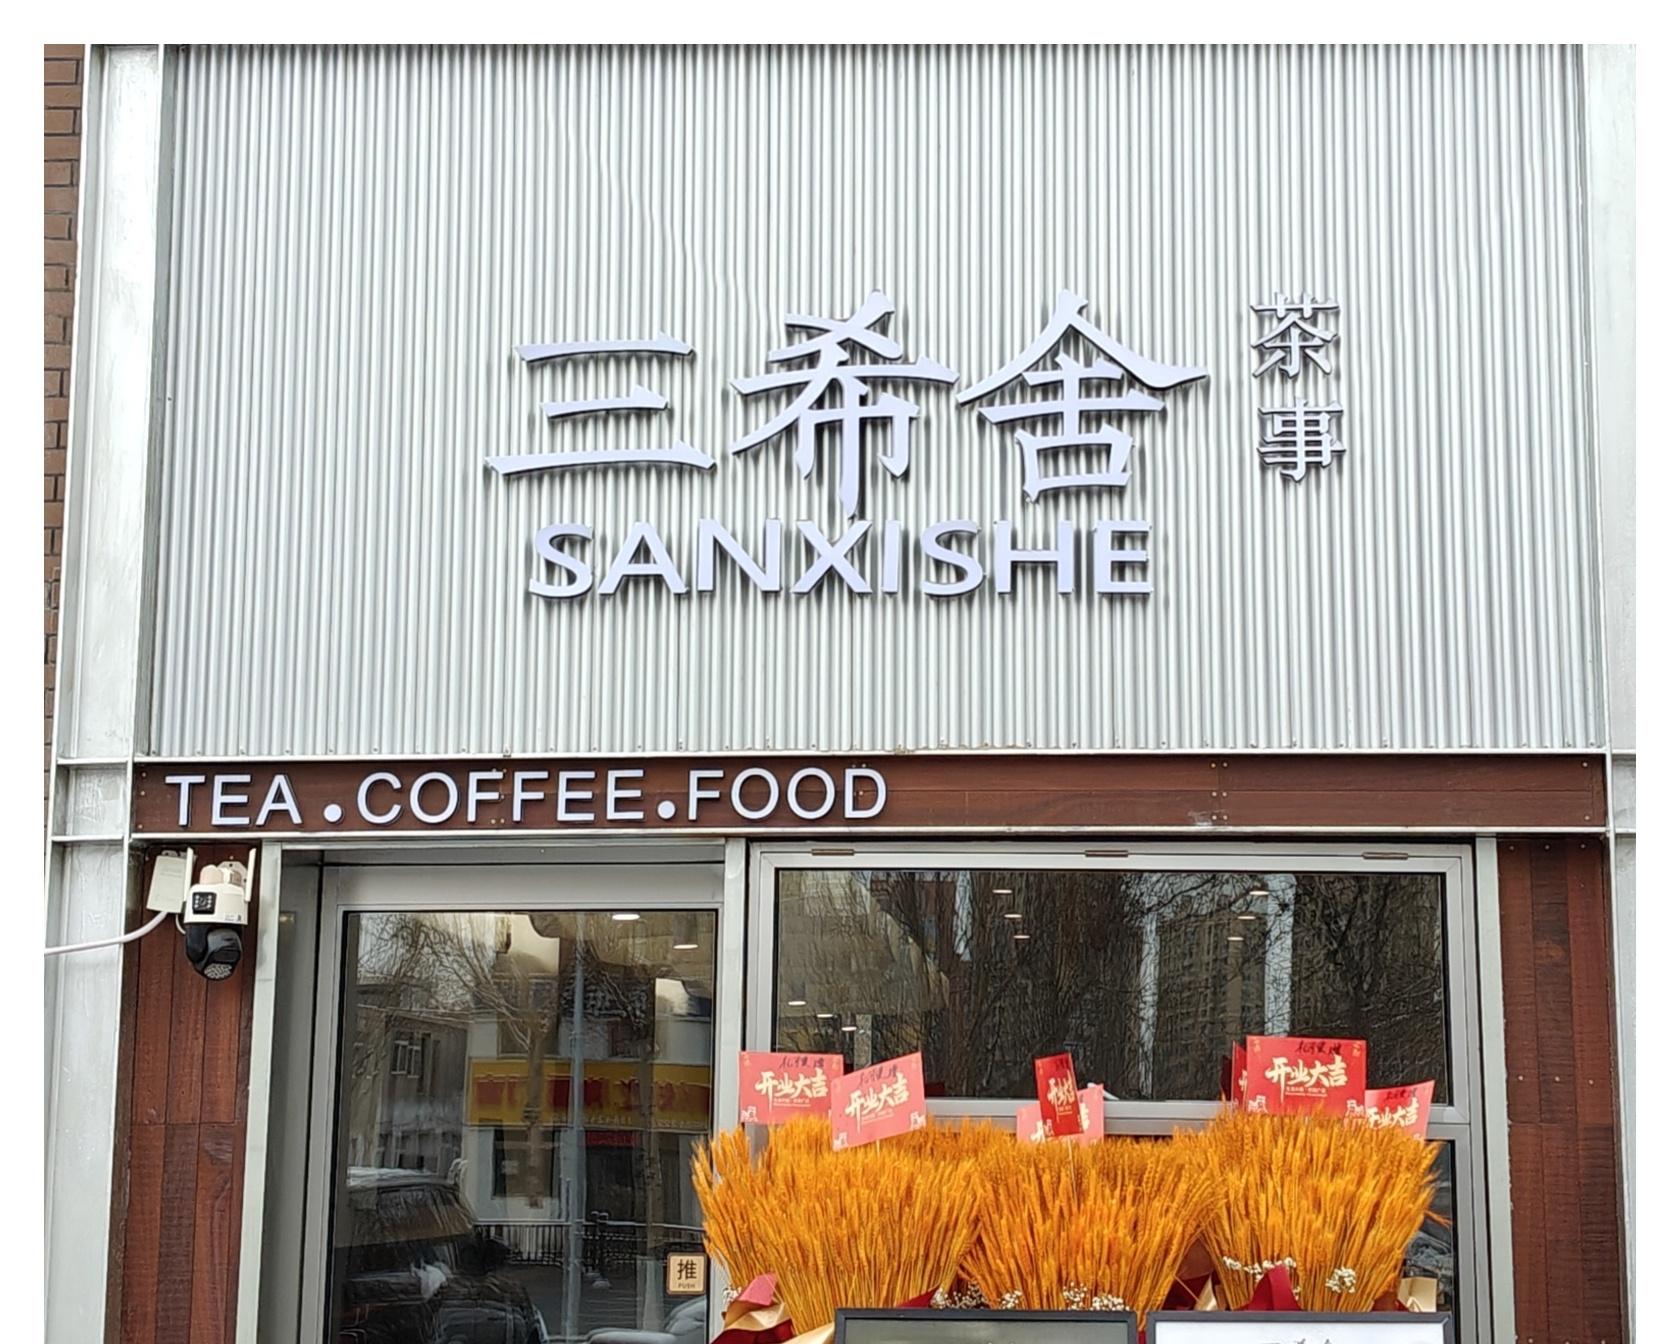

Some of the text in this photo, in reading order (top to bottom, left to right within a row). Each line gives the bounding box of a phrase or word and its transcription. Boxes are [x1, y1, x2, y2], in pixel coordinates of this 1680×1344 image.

[483, 289, 1210, 519] 三希舍
[1250, 291, 1347, 483] 茶事
[528, 518, 1155, 598] SANXISHE
[165, 767, 888, 828] TEA COFFEE FOOD
[755, 1067, 828, 1113] 开业大吉
[845, 1072, 910, 1134] 开业大吉
[1265, 1052, 1348, 1103] 开业大吉
[677, 1258, 697, 1280] 推
